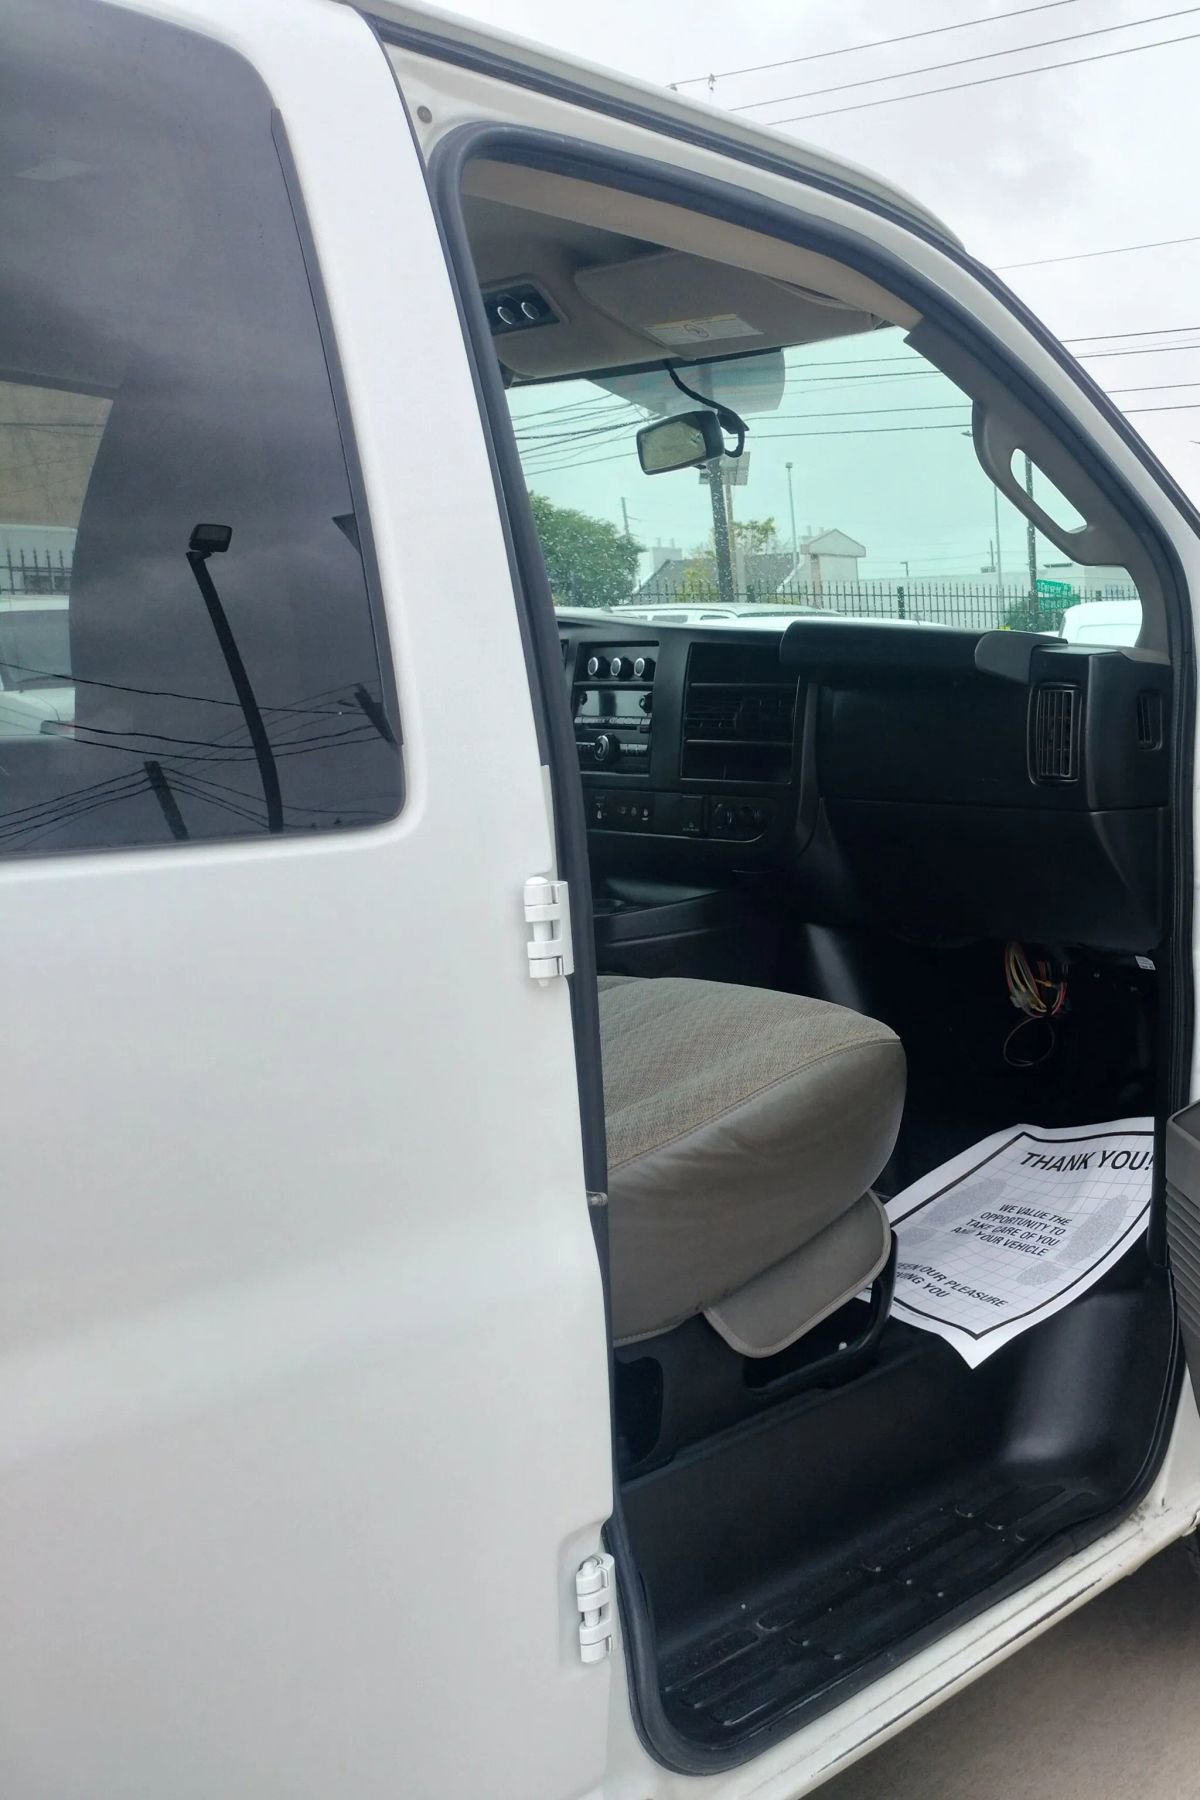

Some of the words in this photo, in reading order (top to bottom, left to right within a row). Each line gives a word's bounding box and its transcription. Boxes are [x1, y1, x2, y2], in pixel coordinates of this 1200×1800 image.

[1020, 1152, 1097, 1172] THANK
[980, 1211, 1051, 1232] OPPORTUNITY
[1049, 1226, 1066, 1236] TO
[999, 1204, 1018, 1213] WE
[1016, 1206, 1051, 1220] VALUE
[1049, 1214, 1072, 1226] THE
[966, 1218, 995, 1230] TAKE
[992, 1226, 1022, 1237] CARE
[1019, 1231, 1037, 1240] OF
[1036, 1235, 1060, 1247] YOU
[976, 1231, 1004, 1245] YOUR
[1003, 1239, 1049, 1257] VEHICLE
[919, 1266, 947, 1281] OUR
[944, 1280, 1008, 1307] PLEASURE
[922, 1283, 951, 1298] YOU
